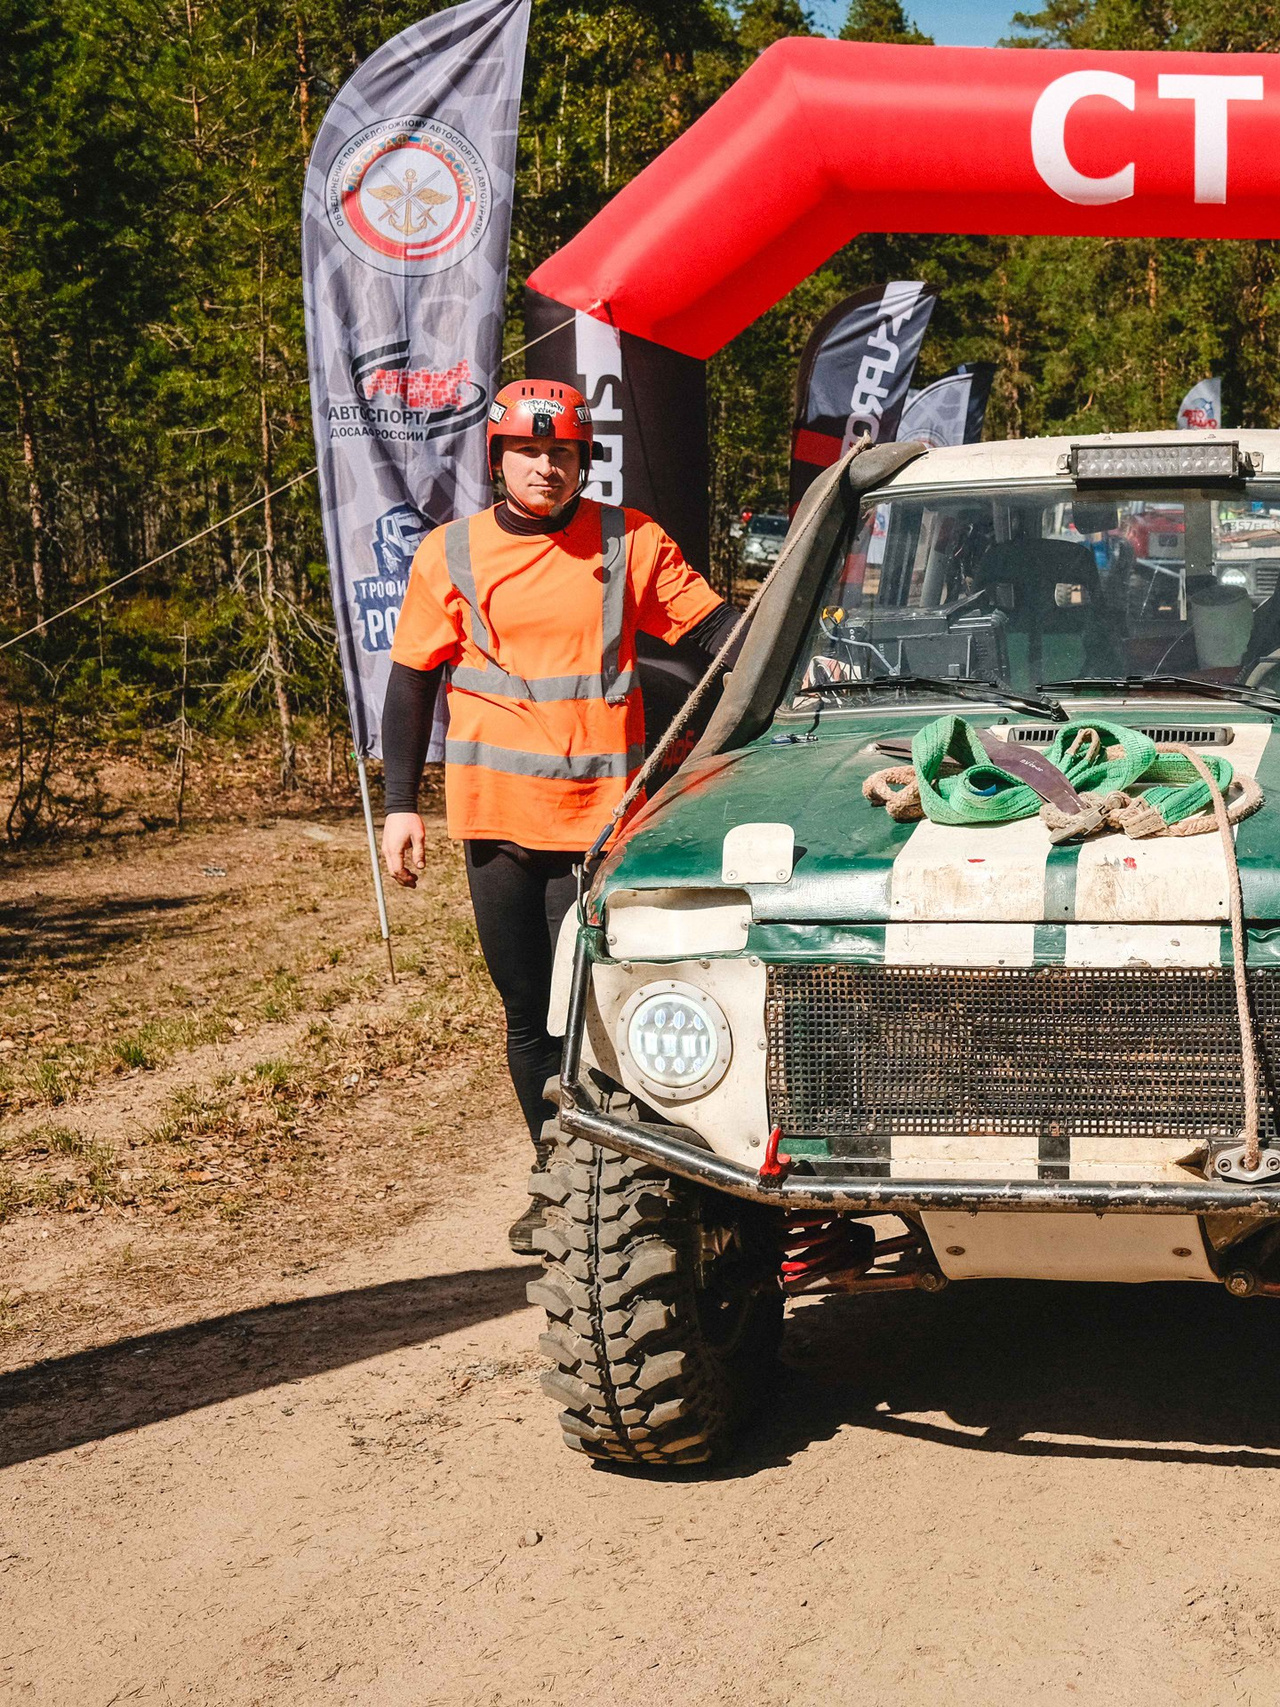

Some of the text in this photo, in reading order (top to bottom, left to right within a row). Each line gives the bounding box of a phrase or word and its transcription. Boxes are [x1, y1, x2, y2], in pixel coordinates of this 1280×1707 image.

[344, 146, 355, 161] ПО
[429, 124, 480, 168] АВТОСПОРТУ
[471, 175, 488, 239] АВТОТУРИЗМУ
[345, 133, 475, 197] ДОСААФ РОССИИ
[328, 405, 423, 425] АВТОСПОРТ
[375, 429, 424, 442] РОССИИ
